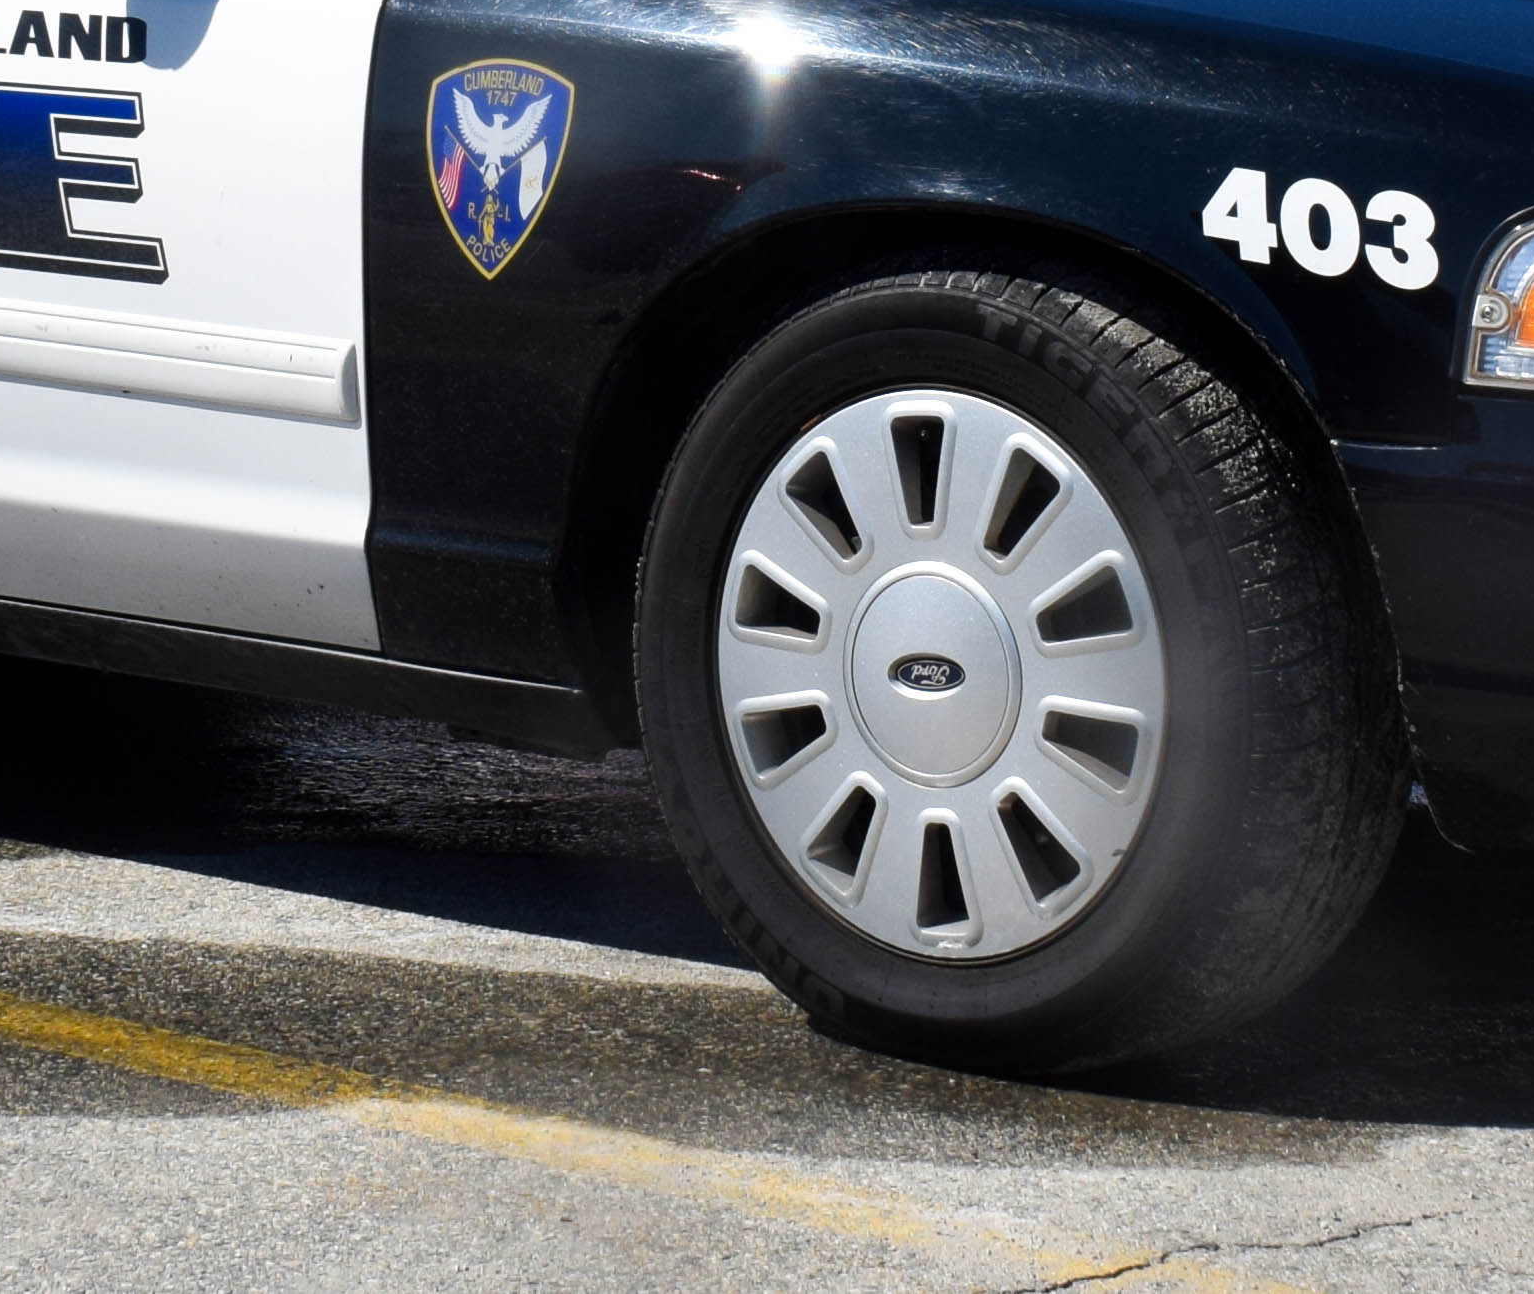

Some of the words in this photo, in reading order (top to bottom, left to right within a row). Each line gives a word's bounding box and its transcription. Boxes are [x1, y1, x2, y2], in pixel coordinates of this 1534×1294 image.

[464, 70, 544, 96] CUMBERLAND
[486, 90, 517, 107] 1747
[1202, 167, 1439, 290] 403
[467, 235, 511, 262] POLICE
